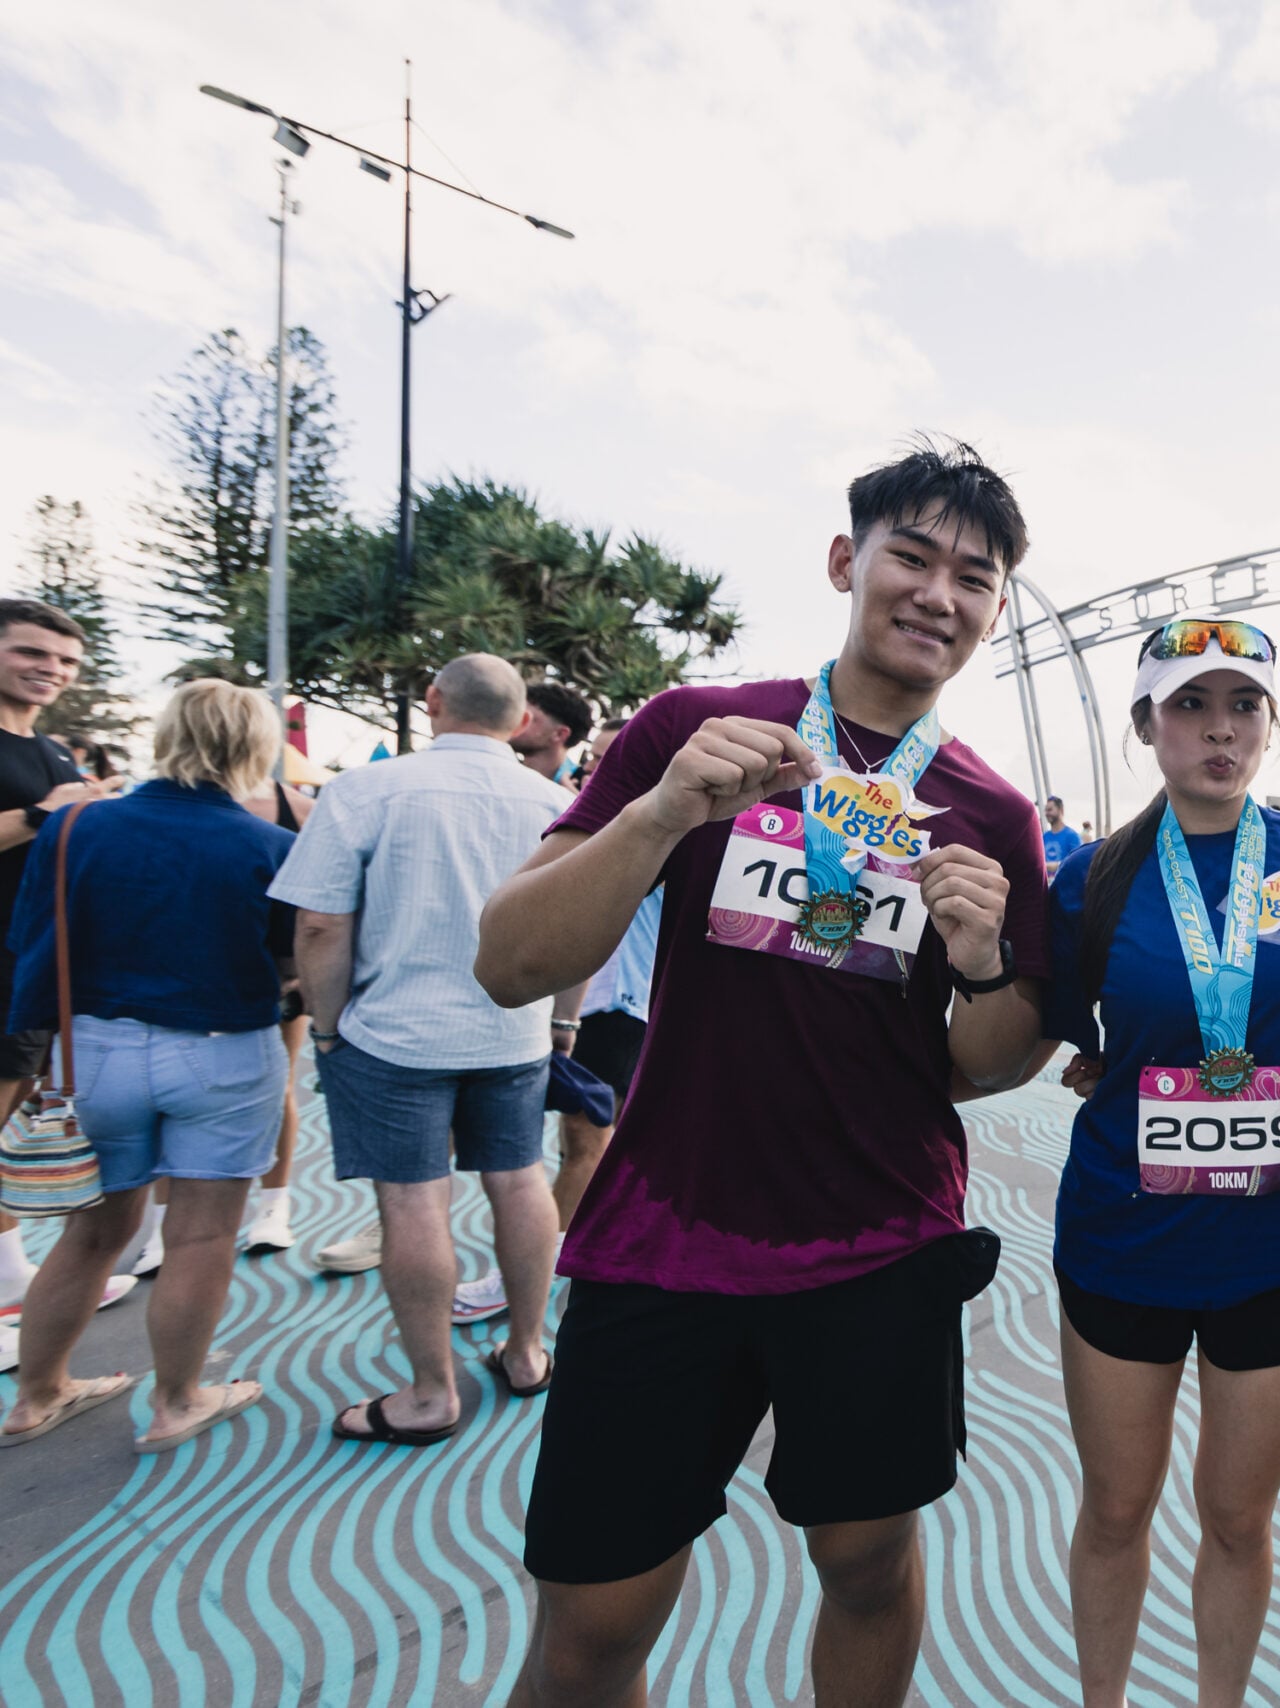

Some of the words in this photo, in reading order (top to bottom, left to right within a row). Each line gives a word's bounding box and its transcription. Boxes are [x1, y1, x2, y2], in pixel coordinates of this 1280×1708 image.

[864, 780, 893, 810] The
[767, 818, 777, 831] B
[812, 784, 923, 857] Wiggles
[1163, 829, 1176, 865] GOLD
[1171, 861, 1190, 901] COAST
[1179, 903, 1214, 975] T100
[1234, 898, 1250, 967] FINISHER
[1163, 1079, 1170, 1091] C
[1208, 1172, 1249, 1189] 10KM
